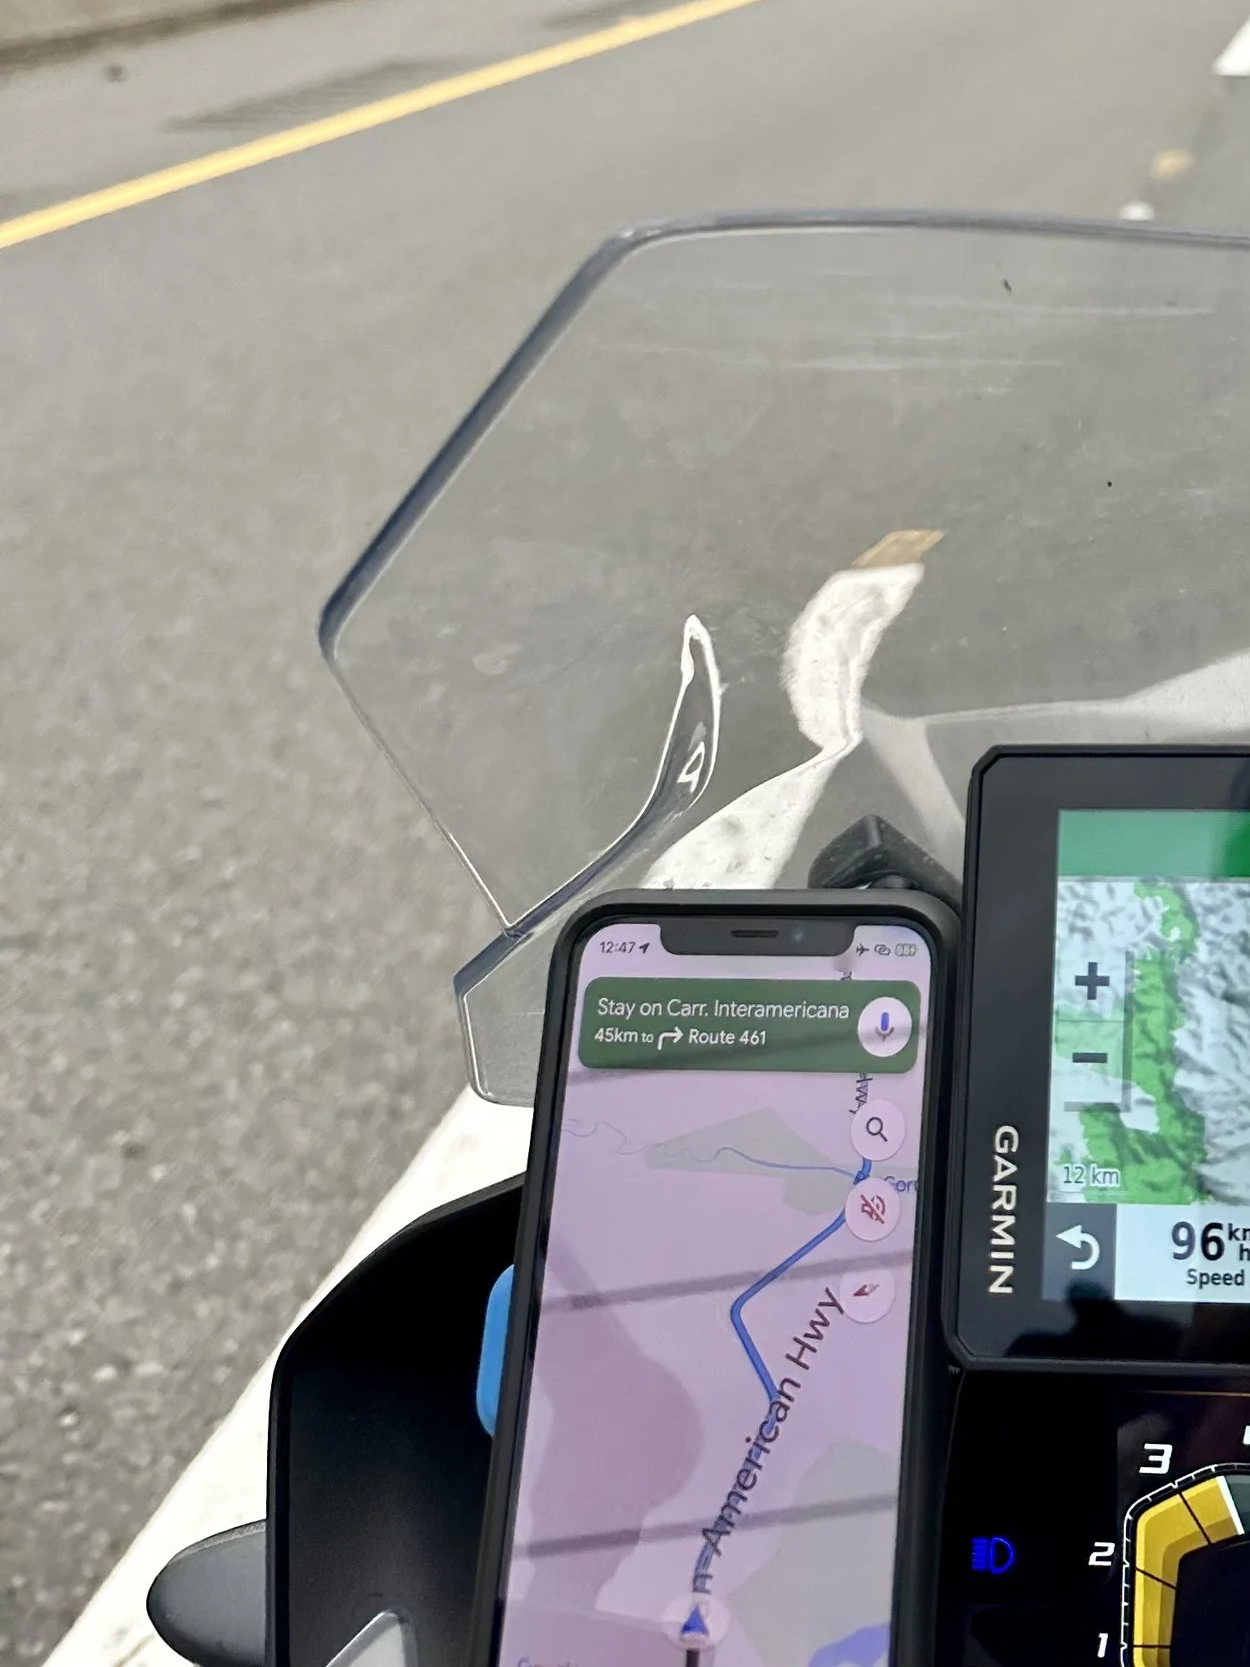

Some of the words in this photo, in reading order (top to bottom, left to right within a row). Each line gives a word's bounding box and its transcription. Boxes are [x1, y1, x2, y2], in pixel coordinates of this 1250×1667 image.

[599, 941, 635, 954] 12:47
[597, 997, 634, 1019] Stay
[640, 1002, 662, 1017] on
[666, 998, 708, 1017] Carr.
[714, 999, 850, 1019] Interamericana
[594, 1027, 638, 1043] 45km
[641, 1031, 654, 1043] to
[688, 1028, 736, 1045] Route
[739, 1029, 767, 1046] 461
[1063, 1166, 1084, 1184] 12
[1091, 1167, 1119, 1185] km
[988, 1124, 1019, 1294] GARMIN
[1171, 1221, 1224, 1261] 96
[1187, 1268, 1245, 1290] Speed
[692, 1377, 801, 1594] n-American
[785, 1287, 845, 1370] Hwy
[1139, 1443, 1173, 1474] 3
[1088, 1542, 1116, 1566] 2
[1096, 1633, 1109, 1658] 1
